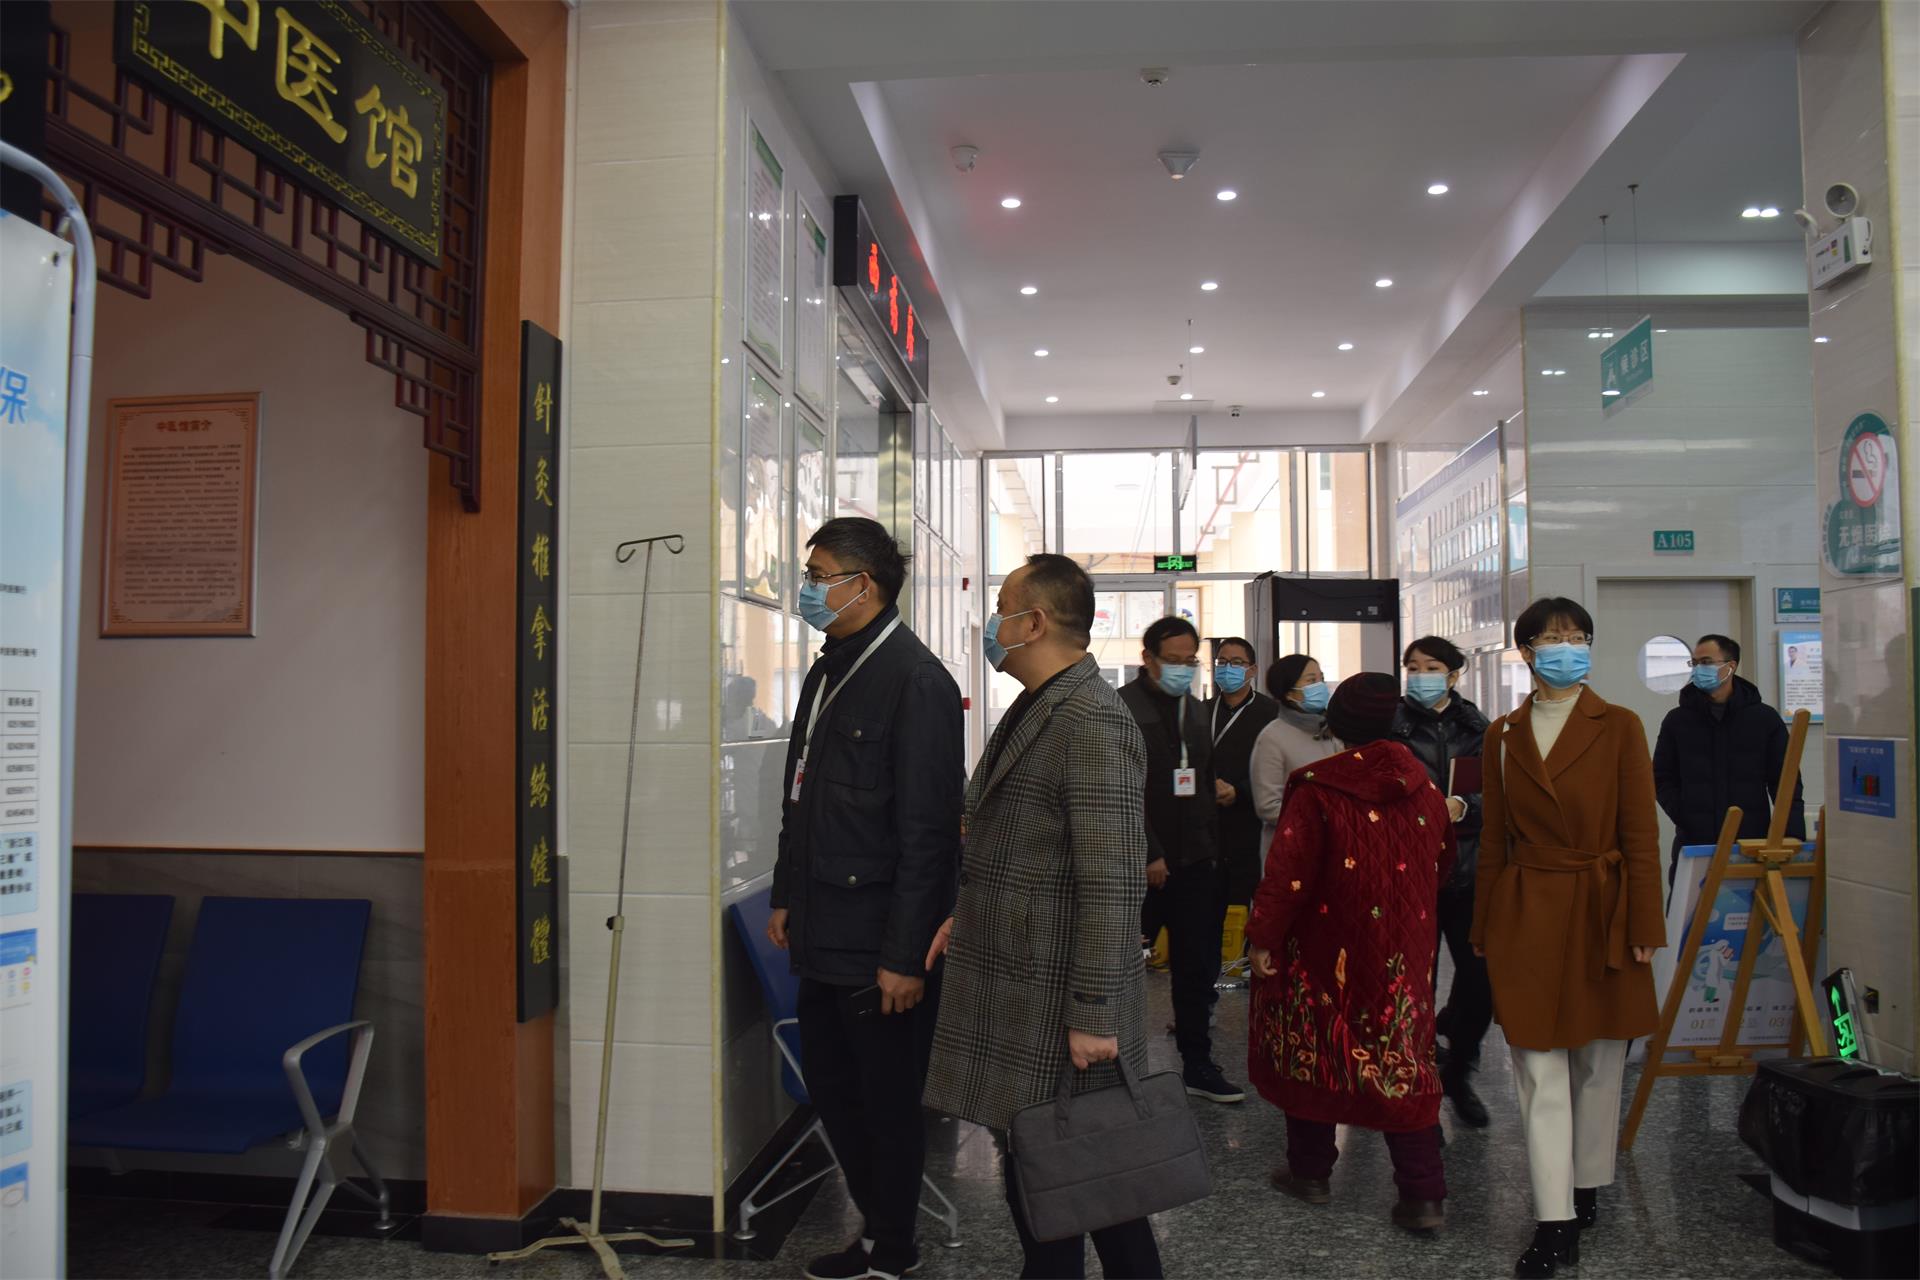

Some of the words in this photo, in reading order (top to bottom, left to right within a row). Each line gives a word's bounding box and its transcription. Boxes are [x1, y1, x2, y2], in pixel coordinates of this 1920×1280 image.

[192, 0, 423, 199] 中医馆
[0, 366, 28, 425] 保
